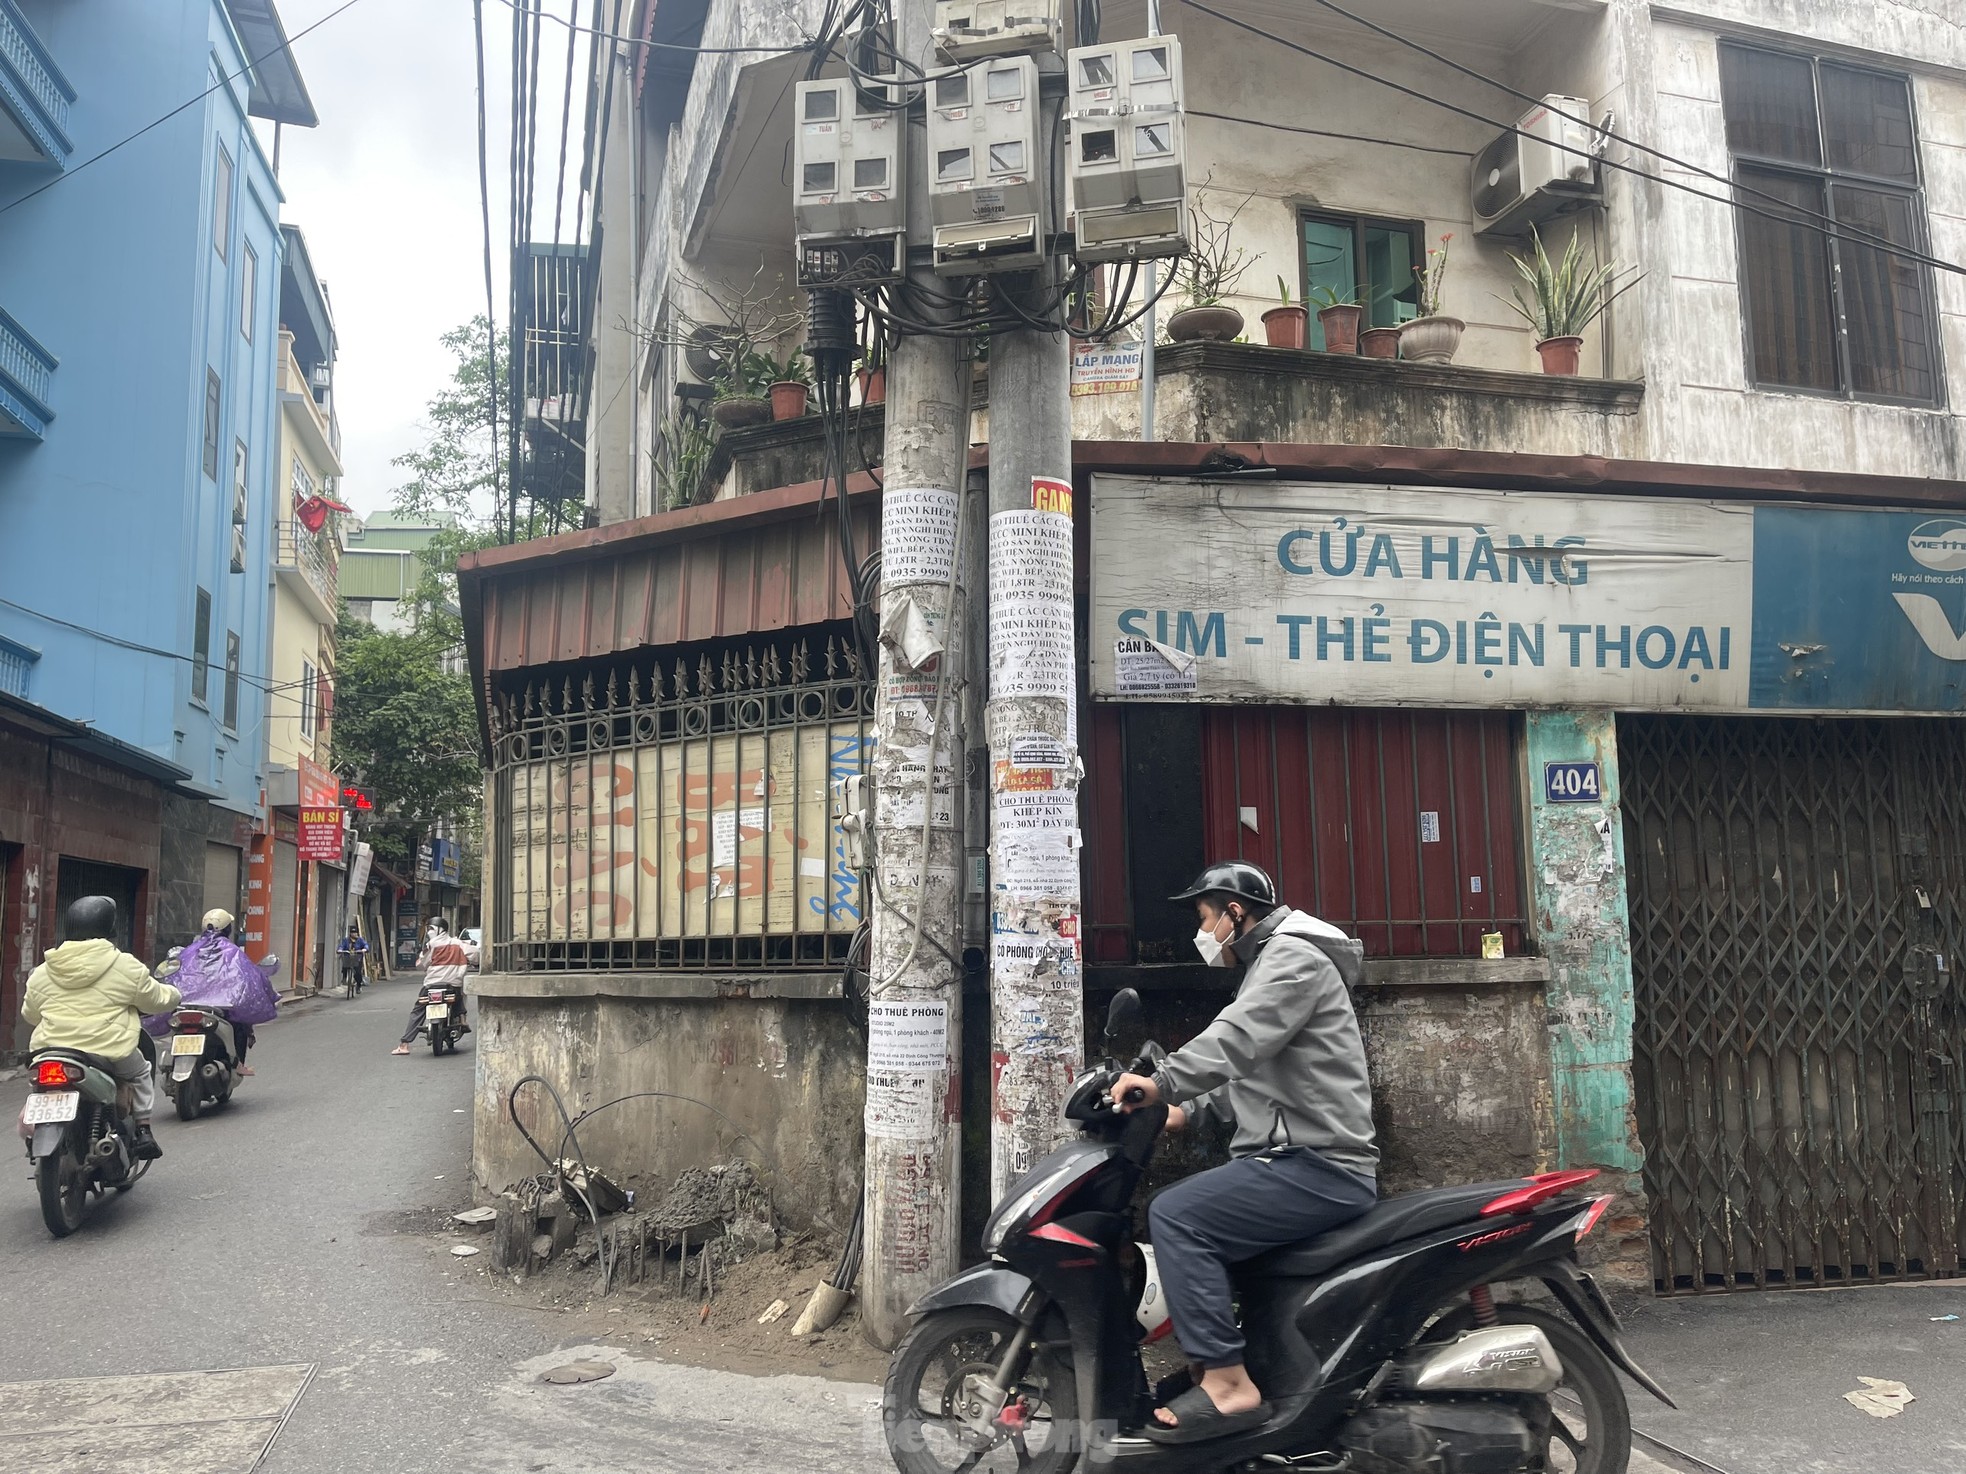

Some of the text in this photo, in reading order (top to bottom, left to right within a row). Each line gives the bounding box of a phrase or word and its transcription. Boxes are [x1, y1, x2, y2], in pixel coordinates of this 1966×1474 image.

[1101, 354, 1139, 366] MẠNG
[1277, 517, 1589, 587] CỬA HÀNG
[890, 568, 917, 578] 0935
[1924, 574, 1943, 584] theo
[1945, 574, 1964, 584] cách
[1006, 590, 1034, 600] 0935
[1117, 608, 1227, 658] SIM
[1276, 603, 1392, 662] THẺ
[1406, 611, 1545, 679] ĐIỆN
[1558, 624, 1730, 684] THOẠI
[1028, 683, 1057, 692] 9999
[1551, 768, 1598, 795] 404
[303, 810, 325, 822] BÁN
[1051, 981, 1062, 990] 10
[871, 1006, 944, 1016] CHO THUÊ PHÒNG
[34, 1094, 70, 1108] 99-H1
[28, 1106, 72, 1122] 336.52
